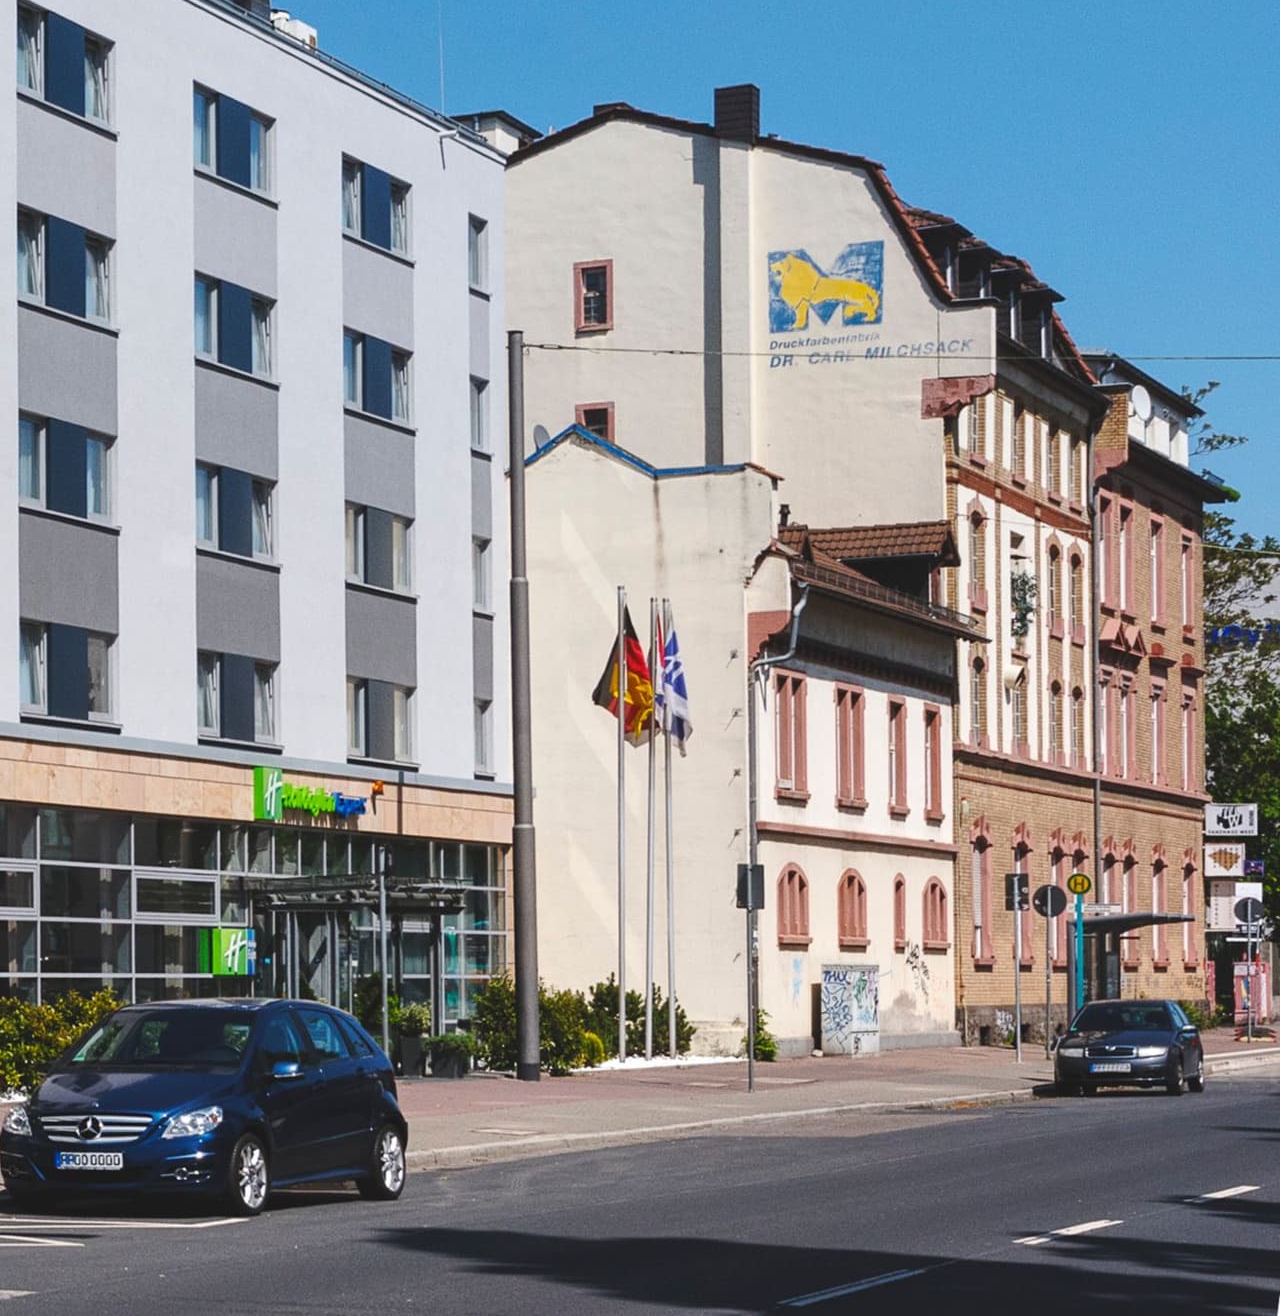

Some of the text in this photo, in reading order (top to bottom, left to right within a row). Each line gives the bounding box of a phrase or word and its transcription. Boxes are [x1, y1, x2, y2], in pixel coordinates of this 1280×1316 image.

[808, 351, 855, 365] CARL
[864, 339, 974, 359] MILCHSACK
[1074, 877, 1085, 890] H
